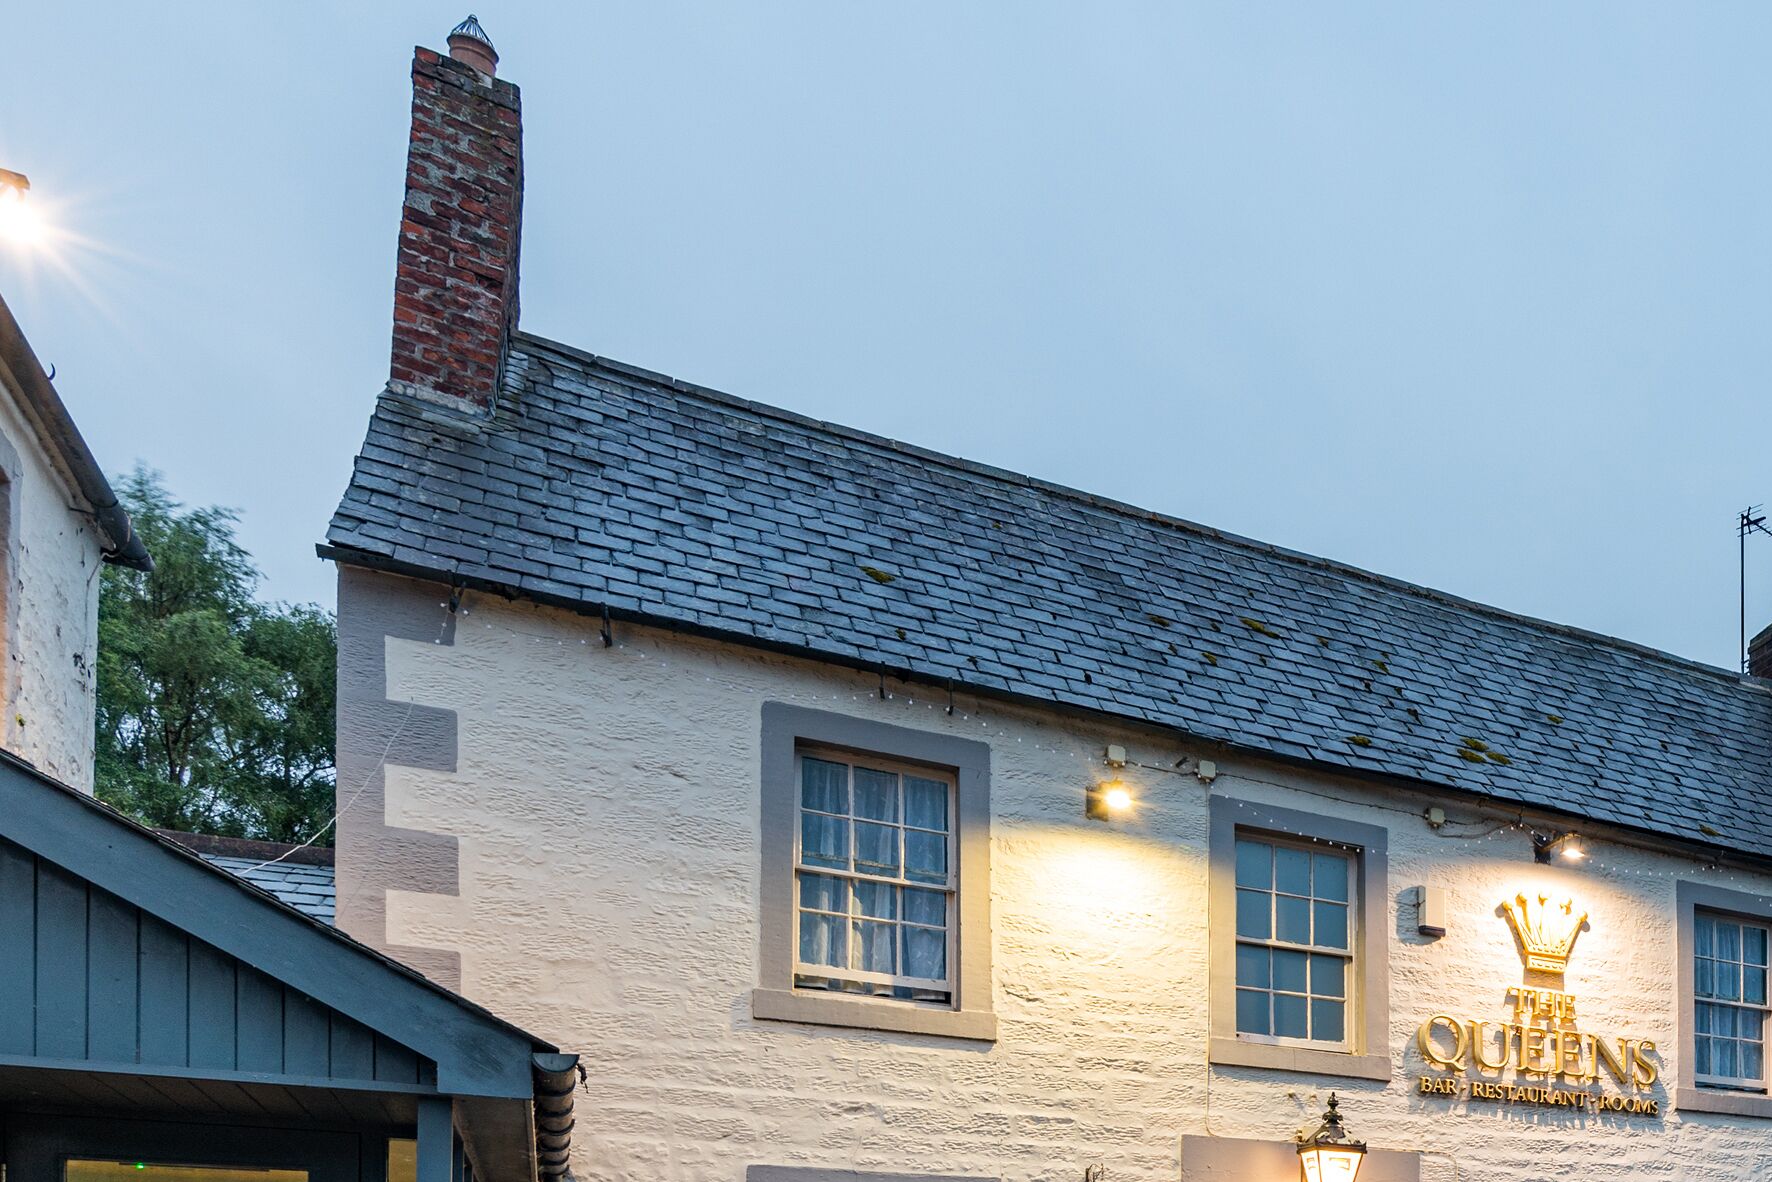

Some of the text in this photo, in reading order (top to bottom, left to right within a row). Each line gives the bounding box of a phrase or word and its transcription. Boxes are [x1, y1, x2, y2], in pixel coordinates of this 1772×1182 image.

[1507, 986, 1577, 1020] THE
[1417, 1015, 1657, 1086] QUEENS
[1420, 1076, 1658, 1115] BAR RESTAURANT ROOMS
